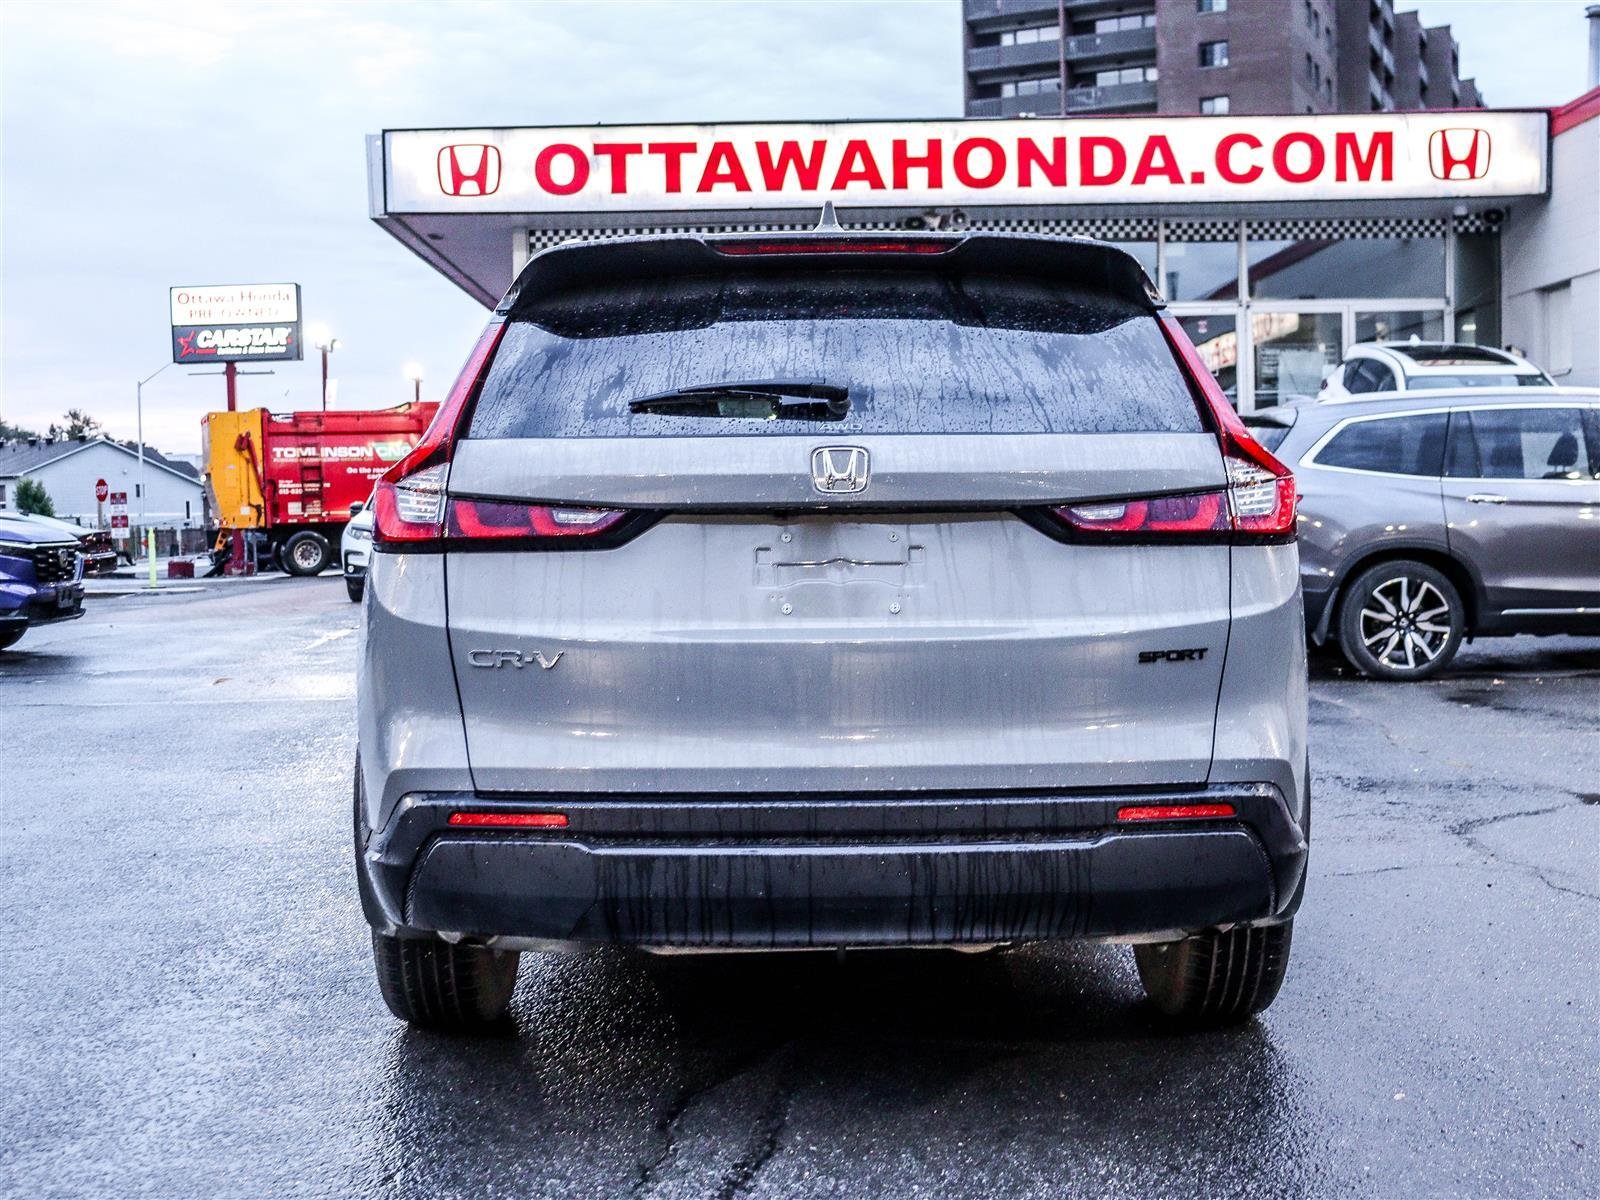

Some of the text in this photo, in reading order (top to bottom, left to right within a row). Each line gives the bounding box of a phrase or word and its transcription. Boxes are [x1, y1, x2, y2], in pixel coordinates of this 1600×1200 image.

[534, 131, 1393, 196] OTTAWAHONDA.COM
[196, 327, 289, 349] CARSTAR
[817, 422, 863, 432] AWD
[272, 446, 374, 458] TOMLINSON
[346, 466, 358, 474] On
[359, 466, 372, 474] the
[467, 649, 565, 669] CR-V
[1138, 647, 1208, 663] SPORT
